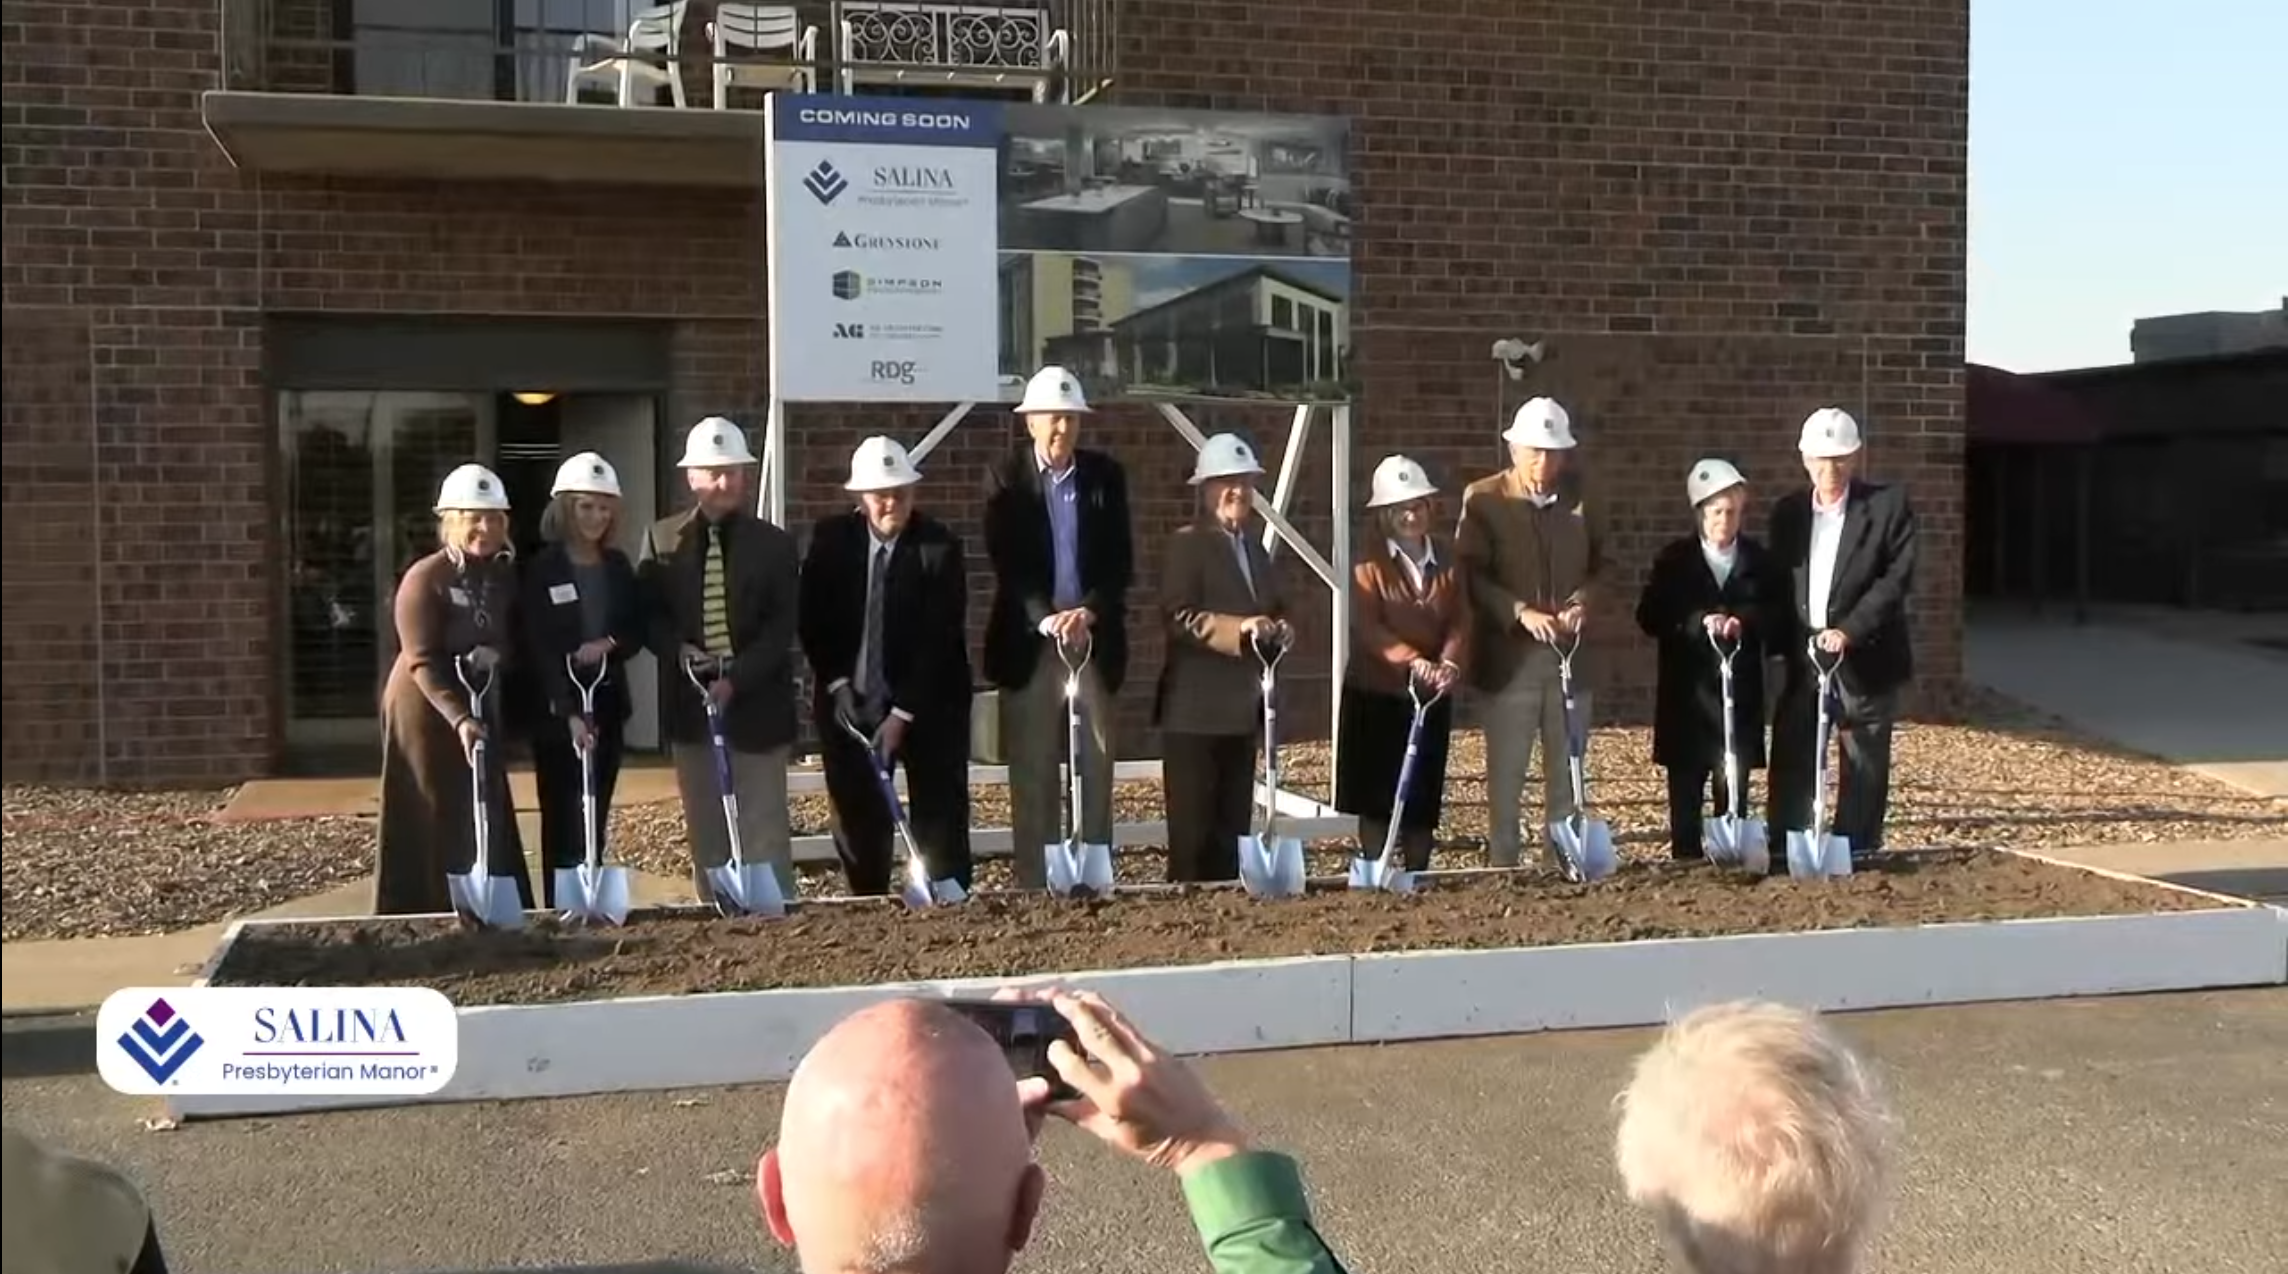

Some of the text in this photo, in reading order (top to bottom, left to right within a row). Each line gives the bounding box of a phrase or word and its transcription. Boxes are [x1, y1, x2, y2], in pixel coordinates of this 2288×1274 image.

[800, 109, 971, 129] COMING SOON
[873, 166, 953, 188] SALINA
